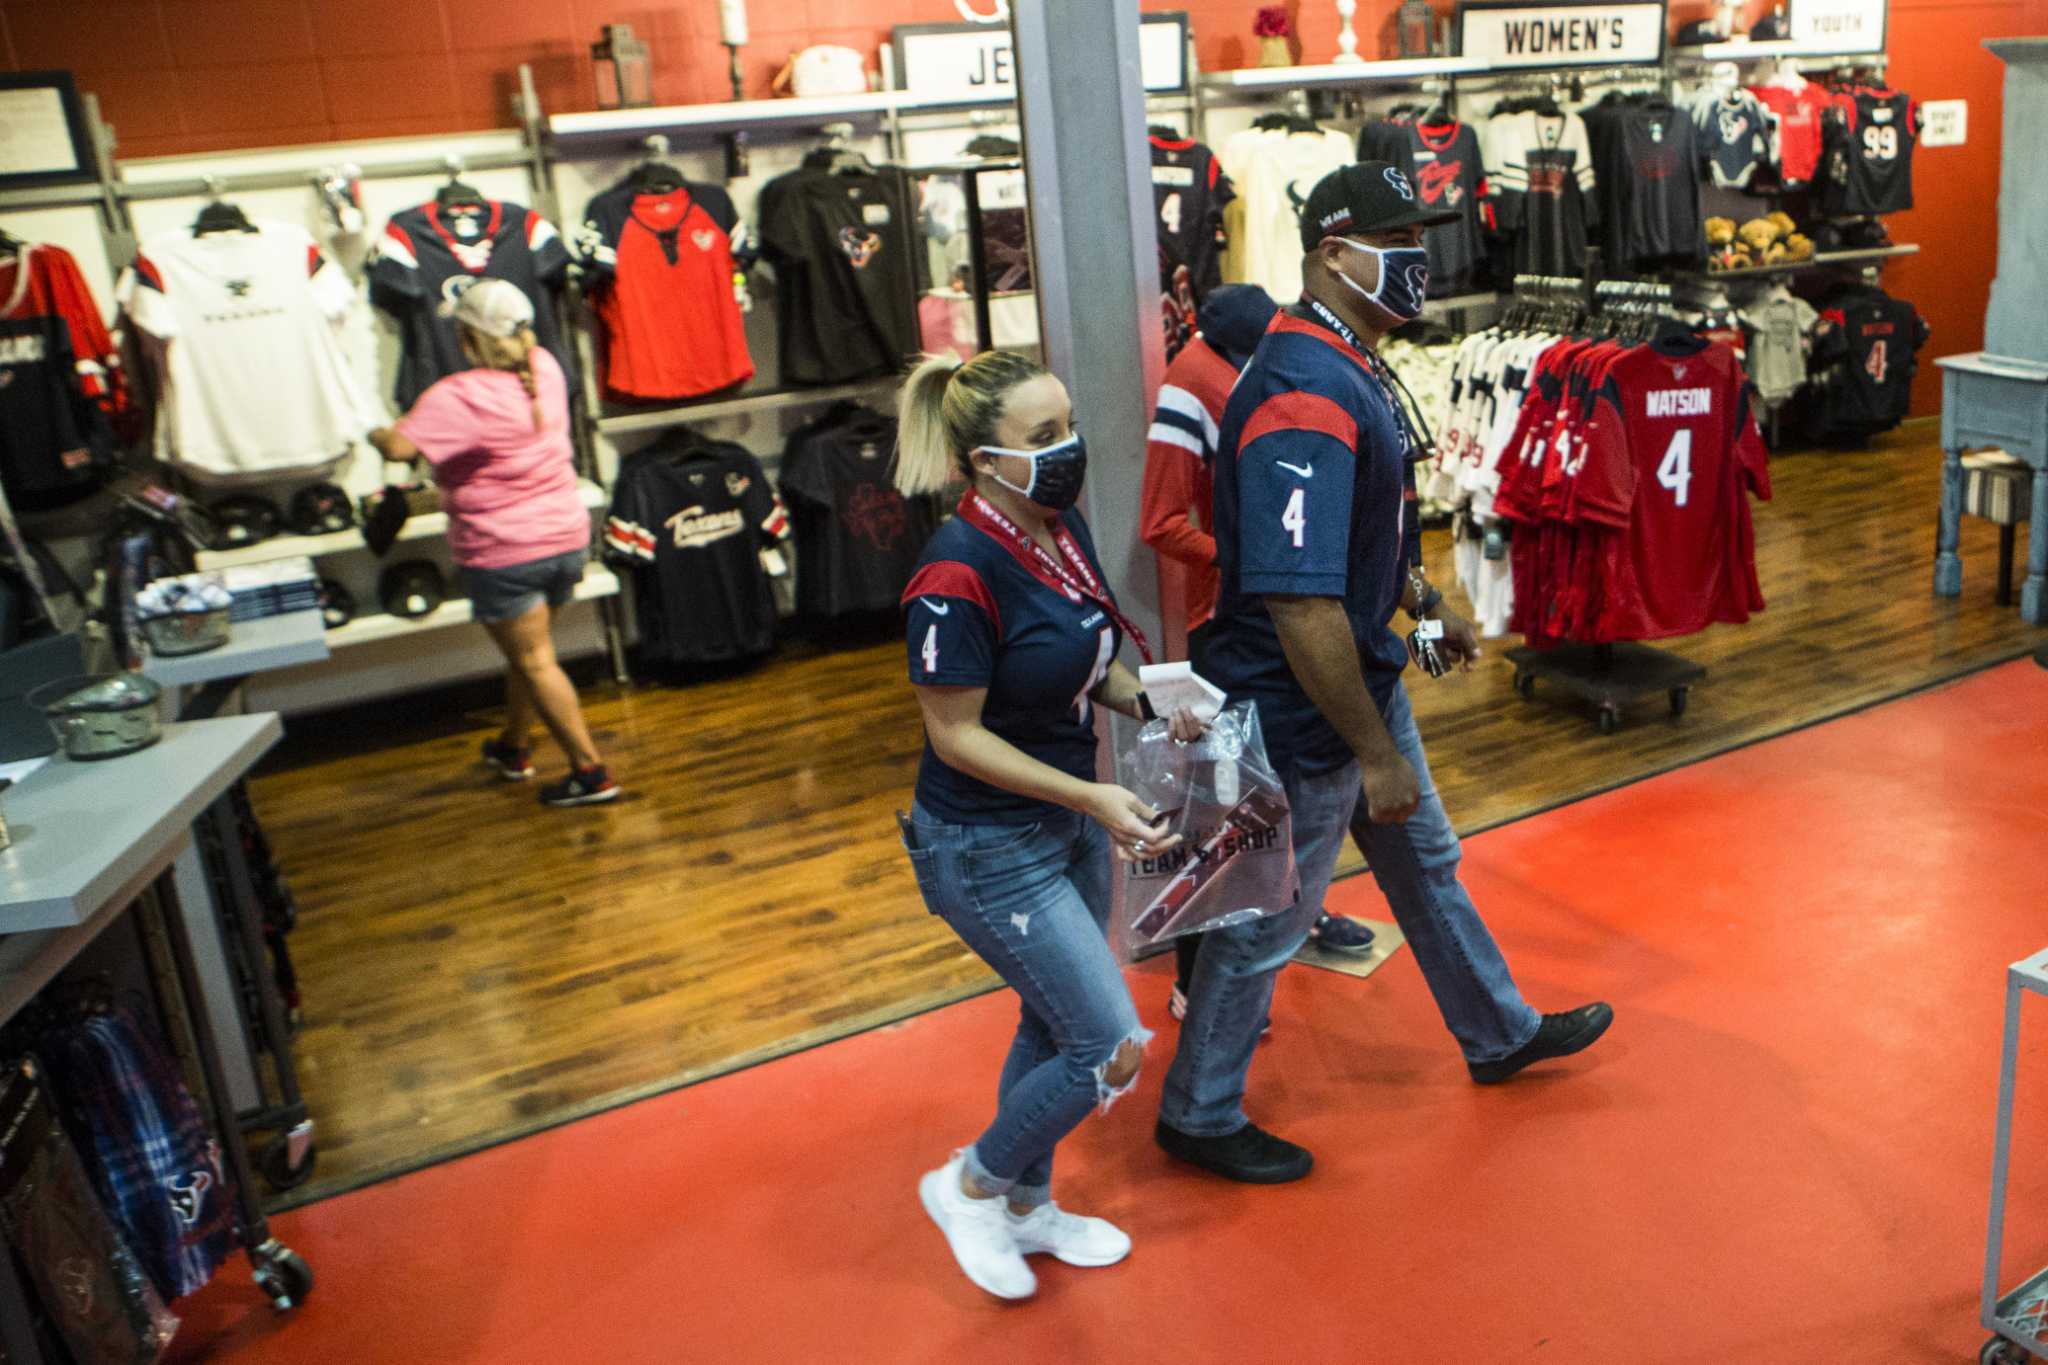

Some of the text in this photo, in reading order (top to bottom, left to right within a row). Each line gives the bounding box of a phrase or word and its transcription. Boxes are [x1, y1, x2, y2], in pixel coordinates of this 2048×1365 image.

[1505, 18, 1623, 54] WOMEN'S
[1811, 13, 1862, 33] YOUTH
[1863, 125, 1898, 160] 99
[1161, 191, 1181, 233] 4
[1864, 339, 1888, 383] 4
[1645, 387, 1712, 417] WATSON
[1656, 428, 1693, 506] 4
[1281, 487, 1307, 548] 4
[1060, 535, 1097, 588] TEXANS
[922, 624, 940, 674] 4
[1223, 826, 1279, 858] SHOP
